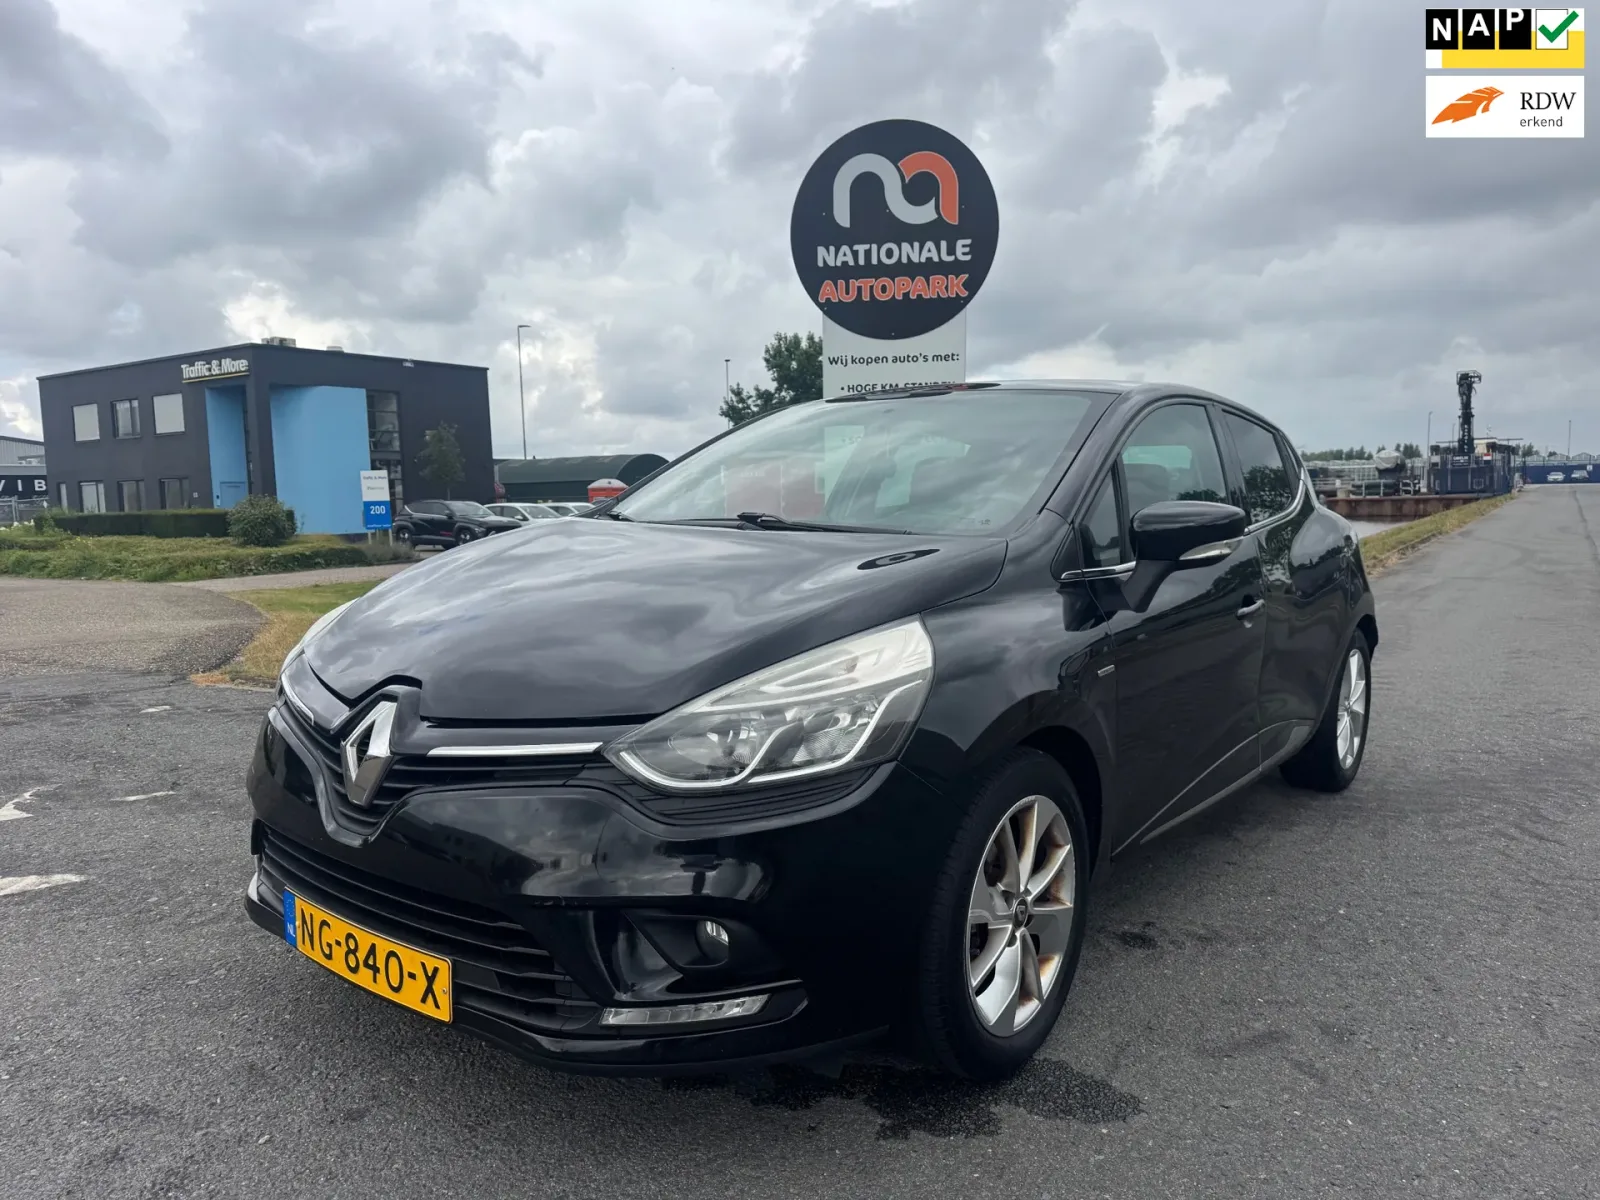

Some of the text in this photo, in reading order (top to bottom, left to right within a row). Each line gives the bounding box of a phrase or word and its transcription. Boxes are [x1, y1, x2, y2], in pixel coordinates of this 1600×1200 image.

[817, 238, 972, 267] NATIONALE
[818, 273, 969, 303] AUTOPARK
[181, 358, 249, 379] Traffic & More
[828, 352, 960, 367] Wij kopen auto's met:
[370, 505, 386, 515] 200
[287, 922, 296, 938] NL
[300, 906, 441, 1010] NG-840-X
